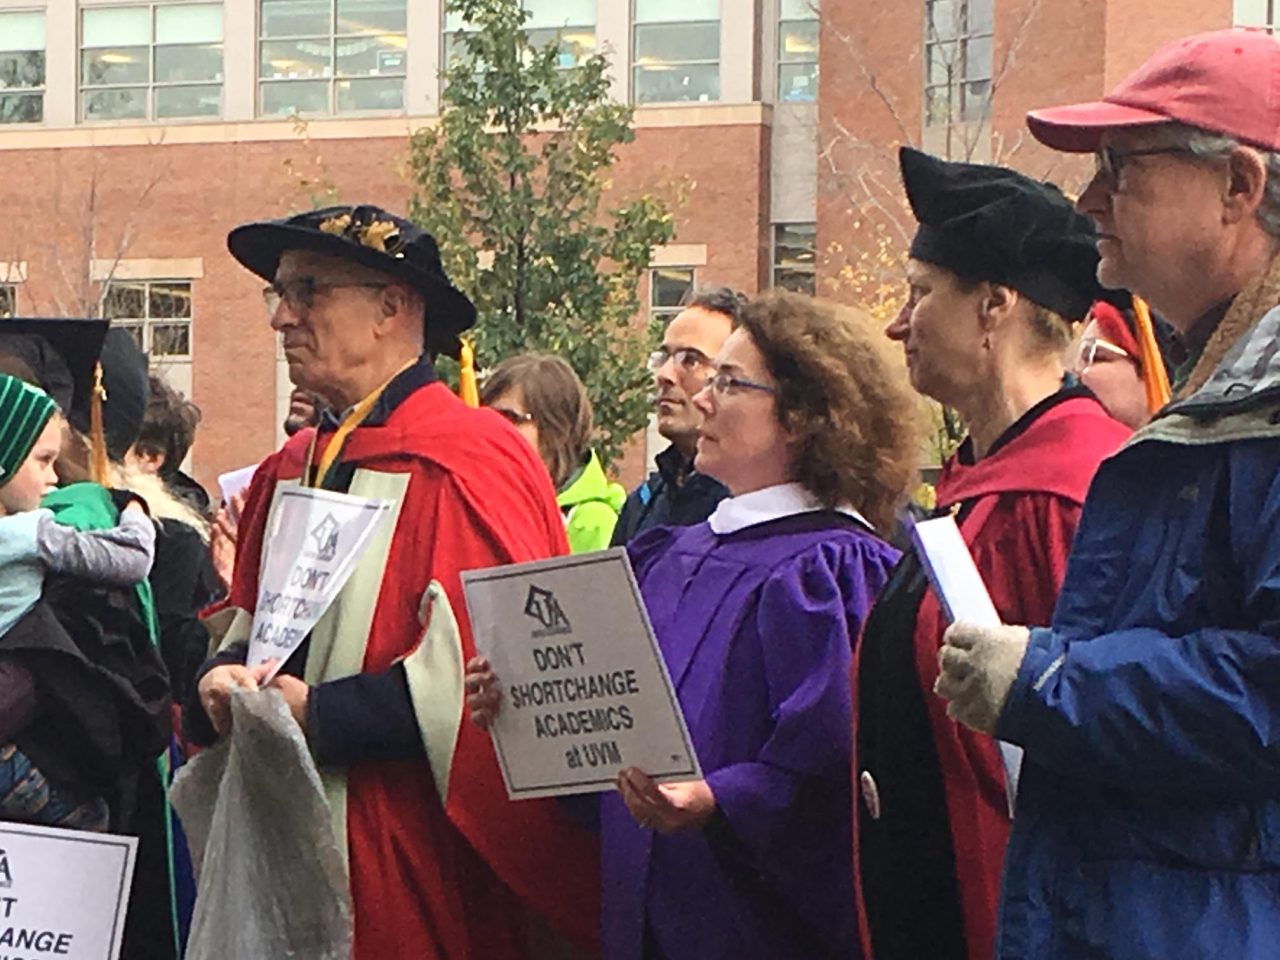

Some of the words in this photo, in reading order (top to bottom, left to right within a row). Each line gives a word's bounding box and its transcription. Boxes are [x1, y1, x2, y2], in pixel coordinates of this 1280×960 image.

[532, 643, 585, 671] DON'T
[510, 669, 639, 708] SHORTCHANGE
[534, 705, 633, 738] ACADEMICS
[565, 744, 583, 768] at
[583, 740, 622, 767] UVM
